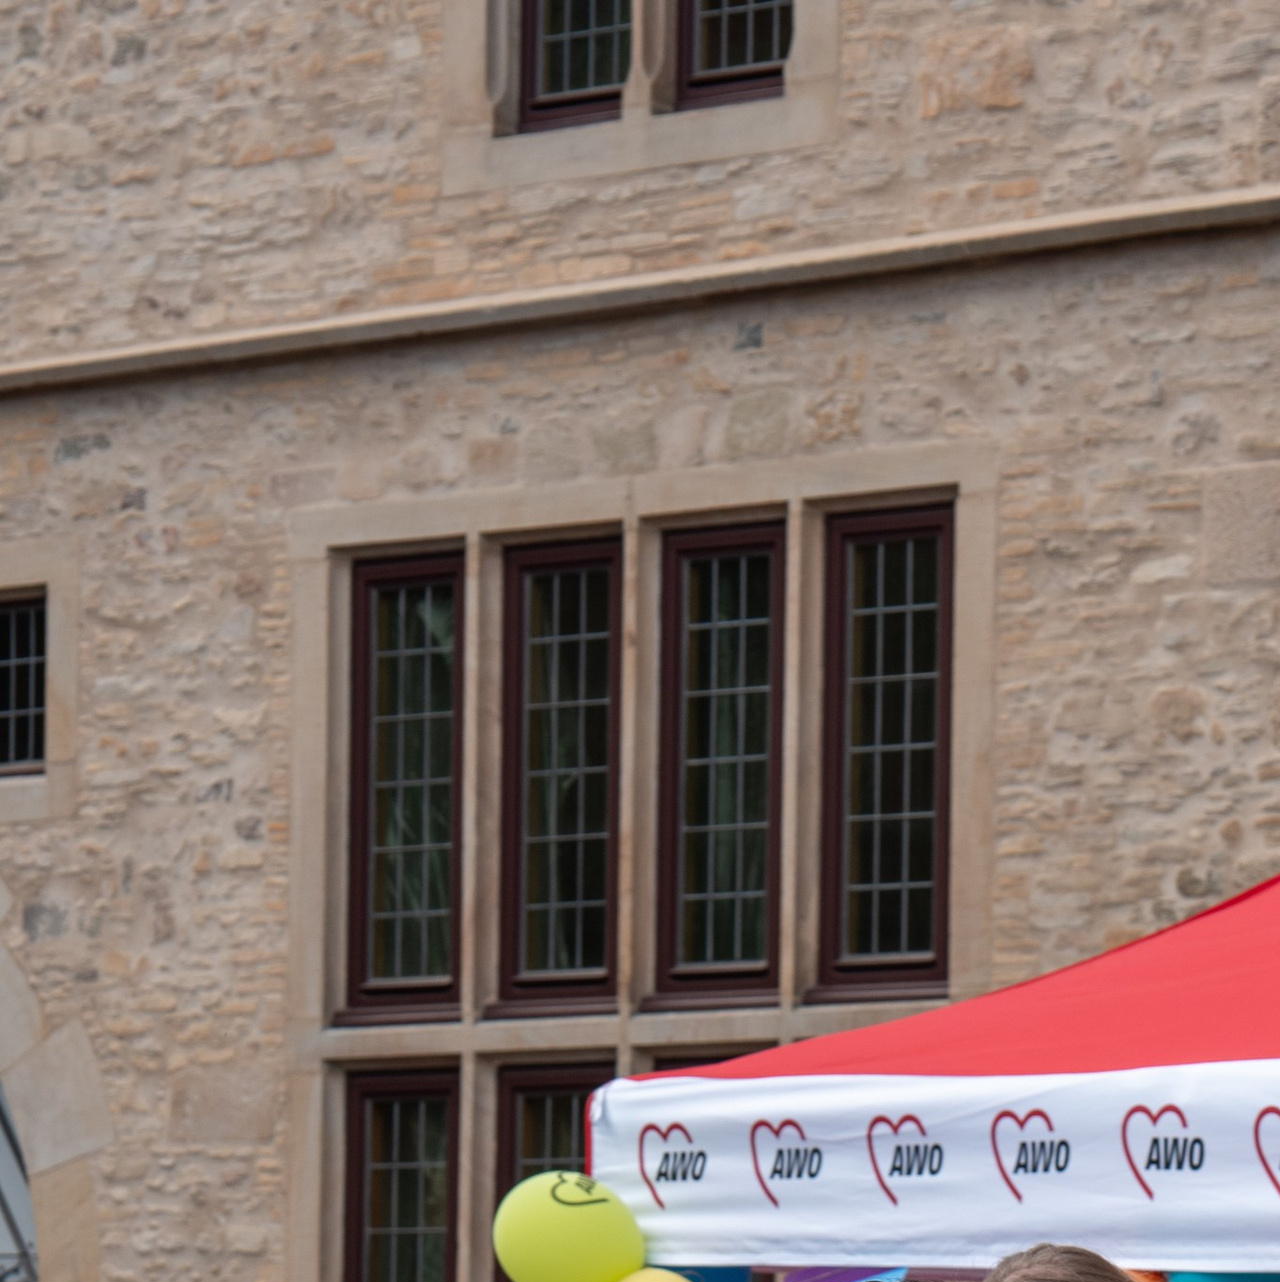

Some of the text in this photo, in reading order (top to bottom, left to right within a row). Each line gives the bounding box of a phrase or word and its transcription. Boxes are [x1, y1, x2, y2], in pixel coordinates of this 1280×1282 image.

[656, 1150, 707, 1181] AWO
[771, 1147, 822, 1178] AWO
[889, 1144, 944, 1175] AWO
[1013, 1140, 1070, 1173] AWO
[1145, 1137, 1205, 1170] AWO
